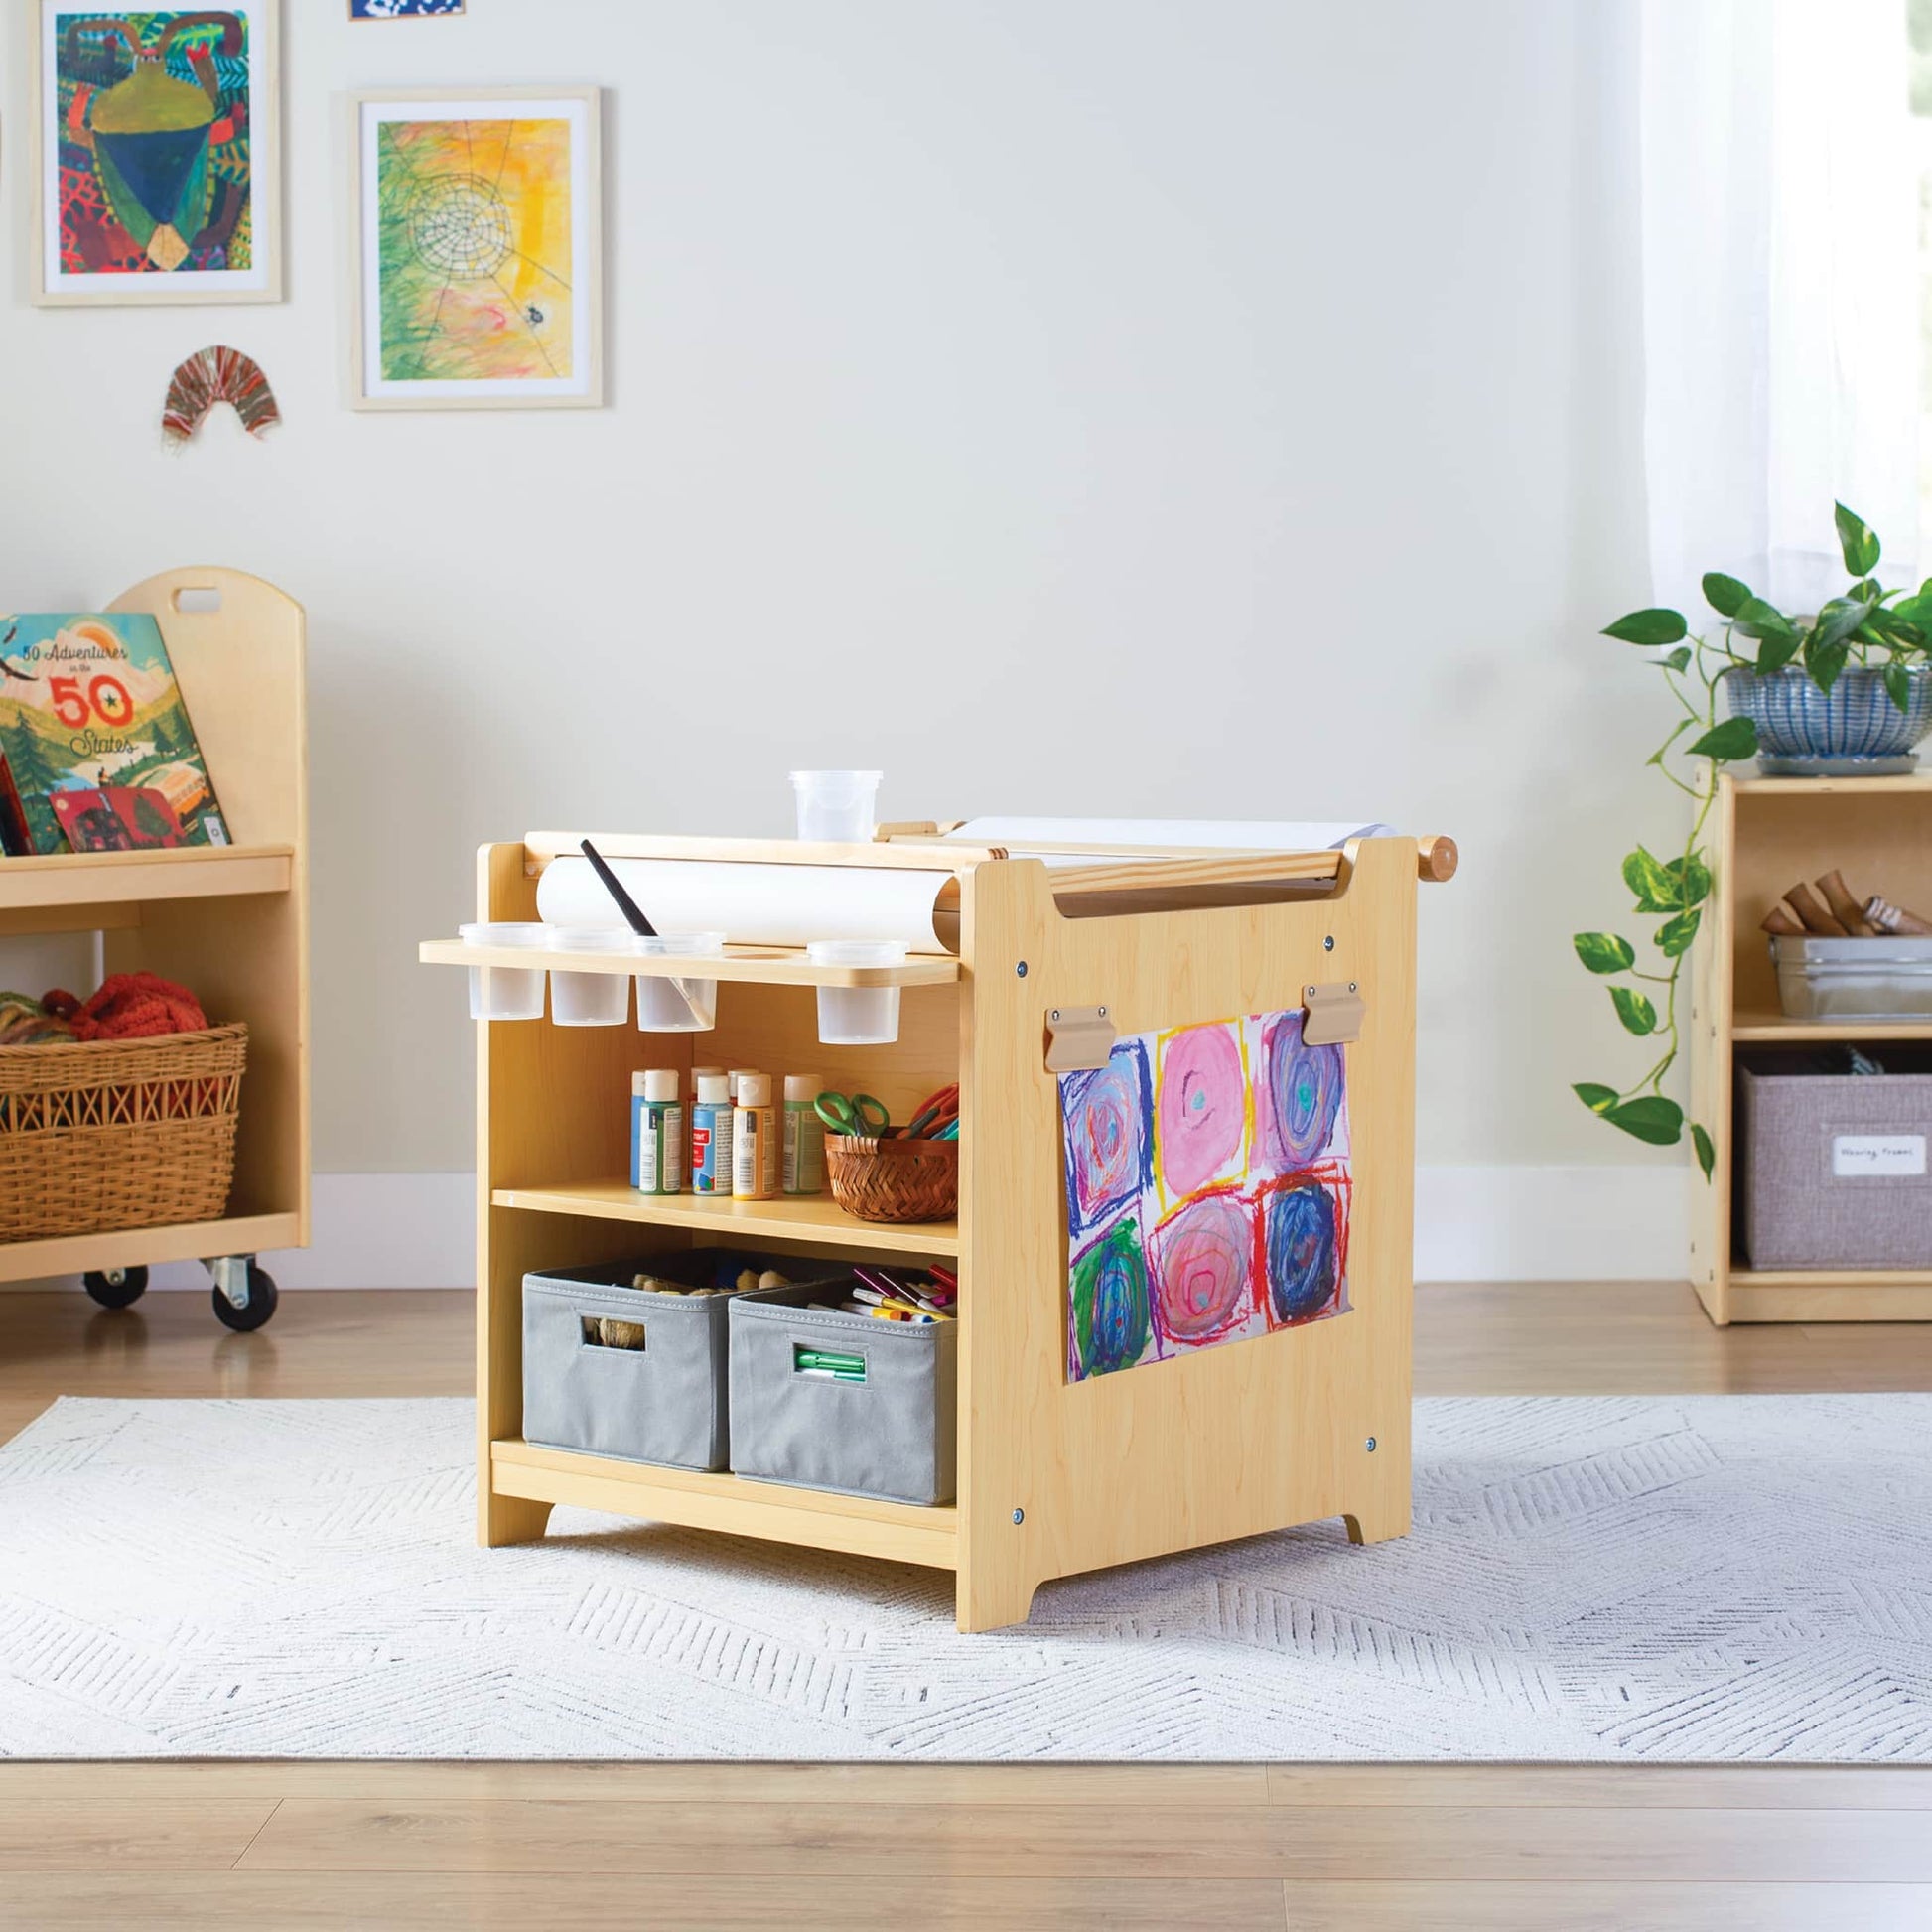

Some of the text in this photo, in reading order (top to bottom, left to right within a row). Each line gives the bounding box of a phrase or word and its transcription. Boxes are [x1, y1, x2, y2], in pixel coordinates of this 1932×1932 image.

[23, 644, 128, 661] 50 Adventures
[49, 675, 133, 729] 50
[70, 729, 139, 758] States
